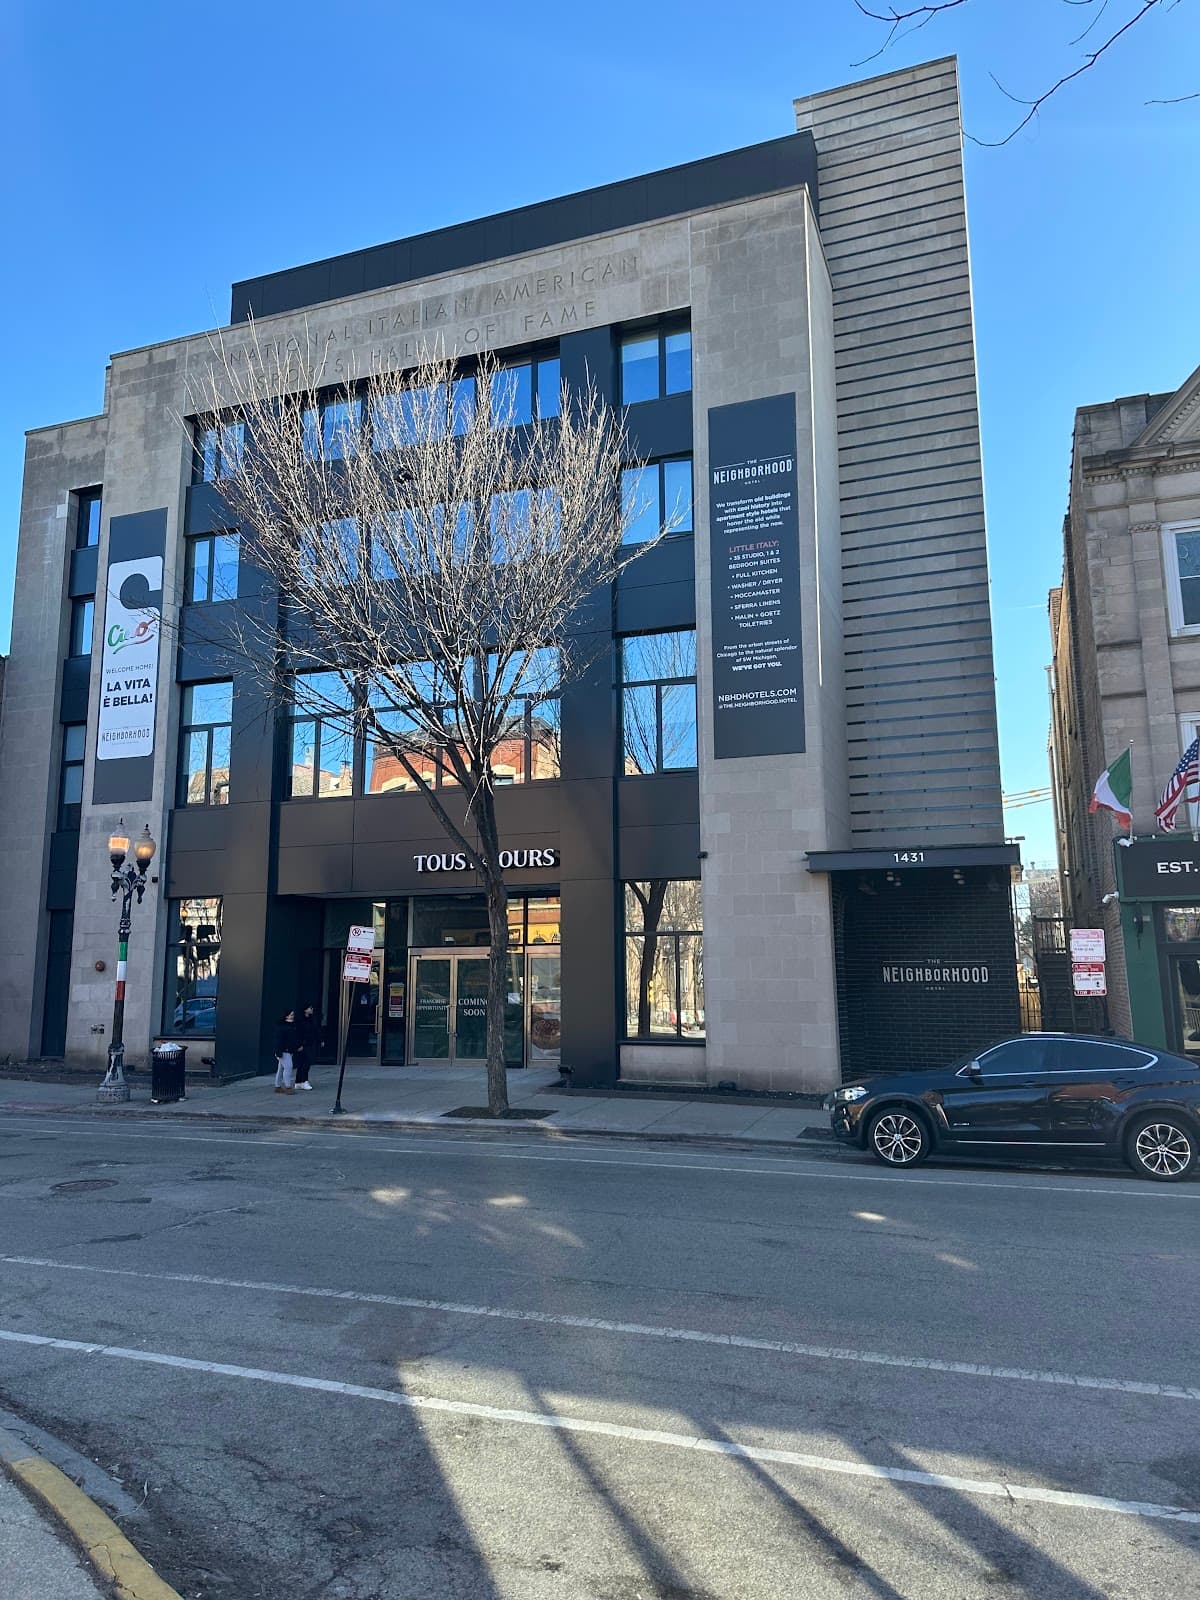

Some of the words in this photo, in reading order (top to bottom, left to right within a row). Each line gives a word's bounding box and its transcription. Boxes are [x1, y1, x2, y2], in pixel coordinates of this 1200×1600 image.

[230, 326, 351, 365] NATIONAL
[368, 297, 468, 335] ITALIAN
[493, 256, 639, 306] AMERICAN
[257, 358, 344, 390] SPORTS
[464, 324, 496, 344] OF
[524, 301, 596, 332] FAME
[713, 459, 793, 485] NEIGHBORHOOD
[726, 498, 754, 507] transform
[764, 492, 791, 501] buildings
[724, 506, 736, 514] with
[750, 503, 770, 511] history
[716, 513, 745, 522] apartment
[746, 510, 760, 518] style
[723, 524, 759, 534] representing
[729, 544, 755, 553] LITTLE
[756, 540, 780, 549] ITALY:
[741, 551, 765, 560] STUDIO,
[728, 561, 759, 570] BEDROOM
[759, 557, 781, 566] SUITES
[751, 568, 778, 576] KITCHEN
[731, 581, 757, 590] WASHER
[762, 578, 783, 586] DRYER
[734, 588, 781, 599] MOCCAMASTER
[734, 602, 758, 610] SFERRA
[759, 599, 781, 607] LINENS
[760, 609, 781, 617] GOETZ
[739, 619, 773, 628] TOILETRIES
[774, 645, 798, 653] splendor
[105, 665, 135, 675] WELCOME
[106, 681, 122, 692] LA
[124, 678, 151, 690] VITA
[112, 693, 153, 707] BELLA!
[718, 687, 797, 702] NBHDHOTELS.COM
[413, 852, 467, 872] TOUS
[498, 848, 555, 868] OURS
[893, 852, 925, 863] 1431
[1156, 861, 1199, 874] EST.
[882, 966, 989, 983] NEIGHBORHOOD
[463, 1008, 486, 1017] SOON
